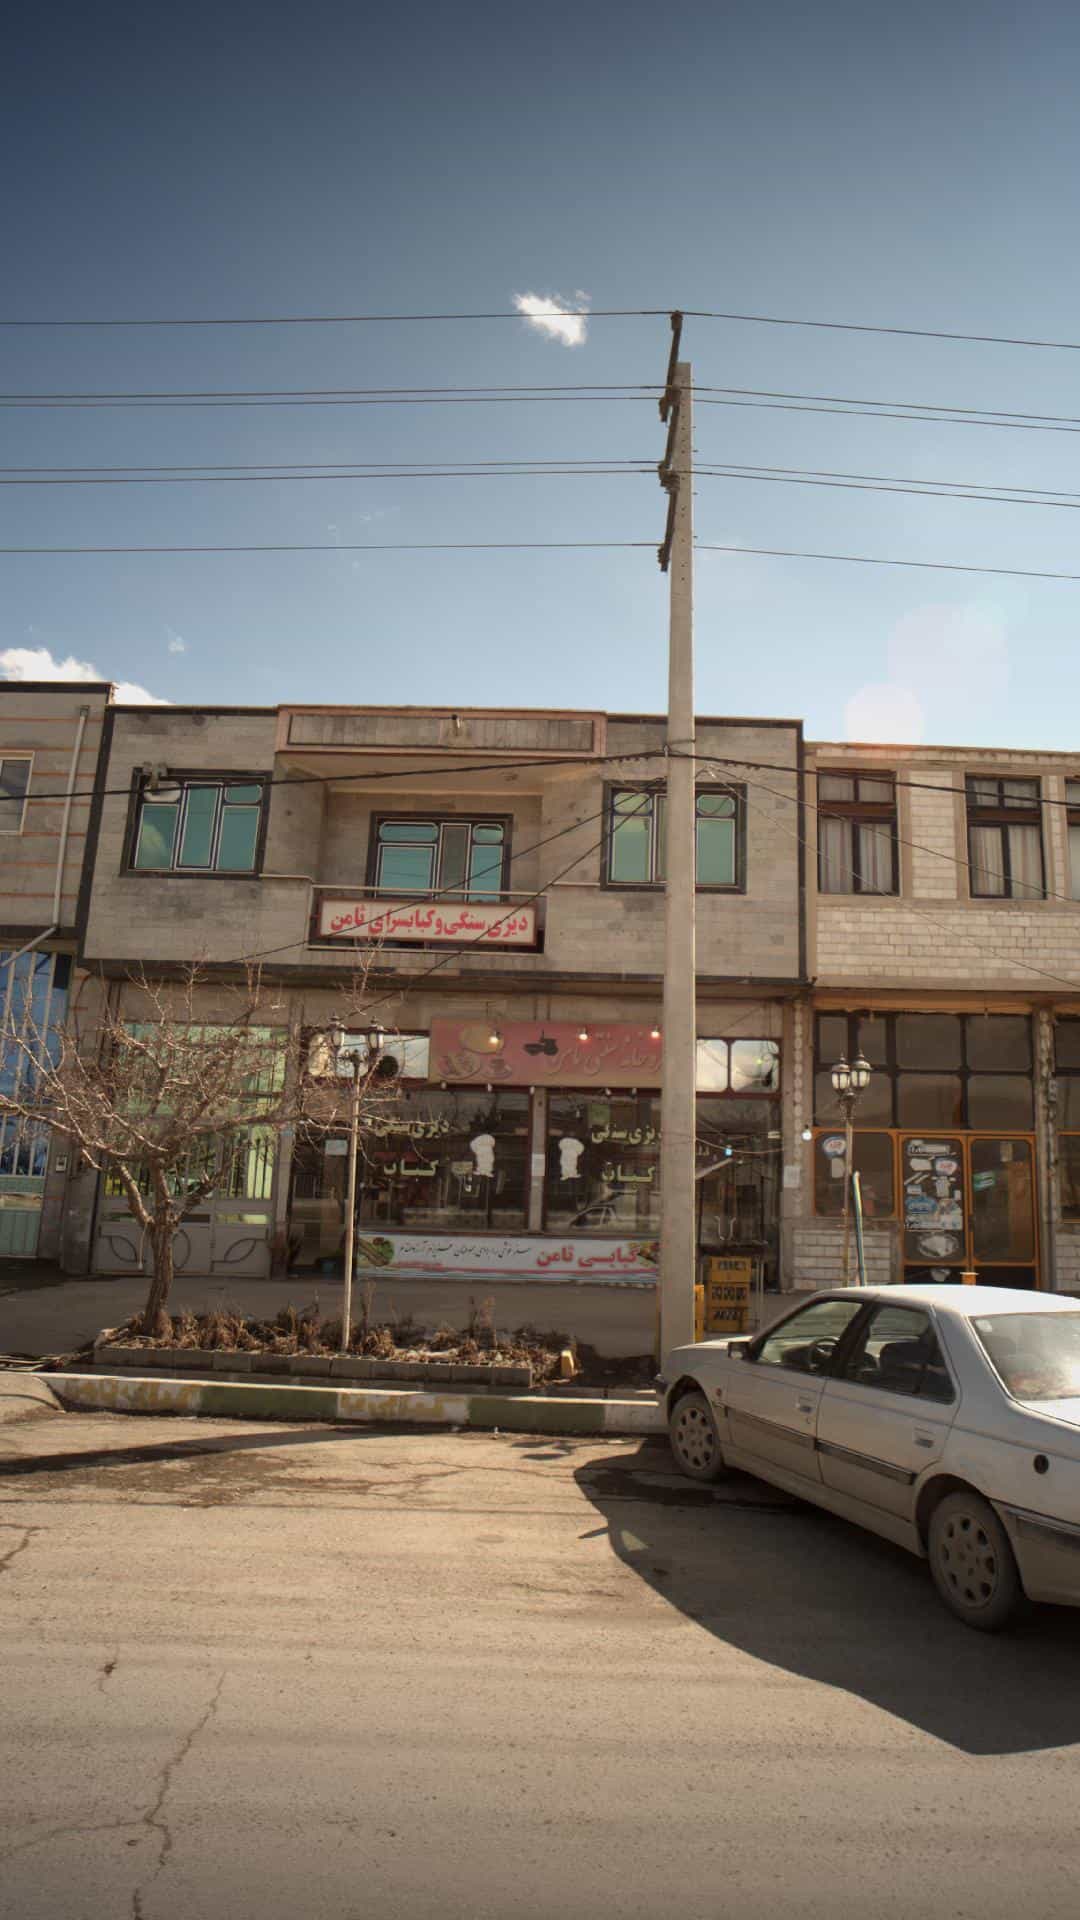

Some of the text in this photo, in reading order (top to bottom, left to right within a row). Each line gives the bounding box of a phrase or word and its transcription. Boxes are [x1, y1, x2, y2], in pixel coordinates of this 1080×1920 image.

[331, 904, 366, 931] ثامن
[434, 917, 443, 935] و
[444, 912, 486, 935] سنگی
[536, 1246, 641, 1268] کبابی ثامن
